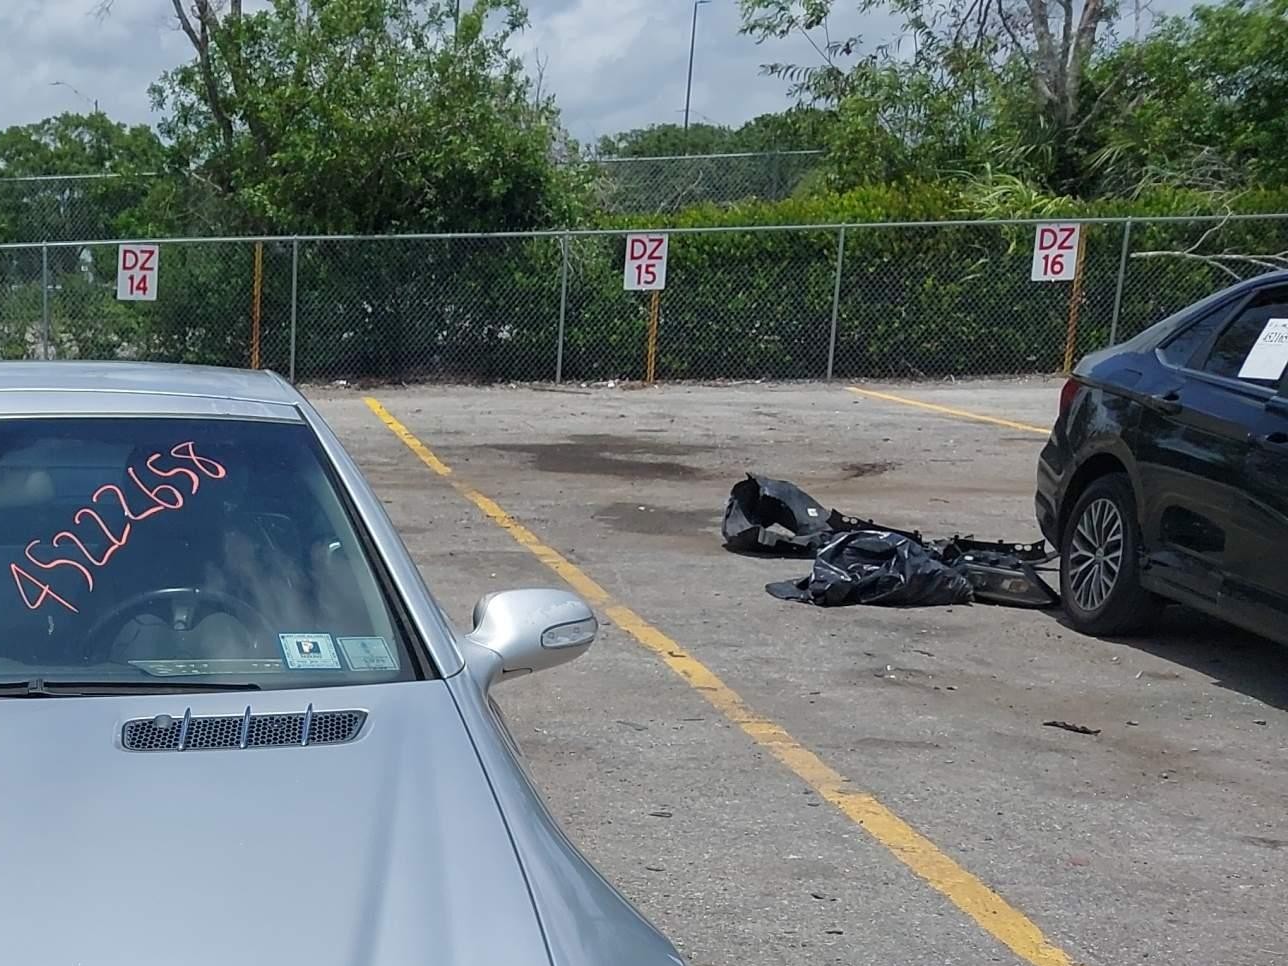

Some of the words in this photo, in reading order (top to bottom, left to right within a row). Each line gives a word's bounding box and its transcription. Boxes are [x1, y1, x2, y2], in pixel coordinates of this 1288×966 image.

[630, 238, 664, 260] DZ
[1039, 227, 1075, 250] DZ
[122, 249, 154, 270] DZ
[1042, 253, 1064, 276] 16
[128, 274, 148, 296] 14
[635, 264, 656, 285] 15
[10, 441, 227, 613] 45222658
